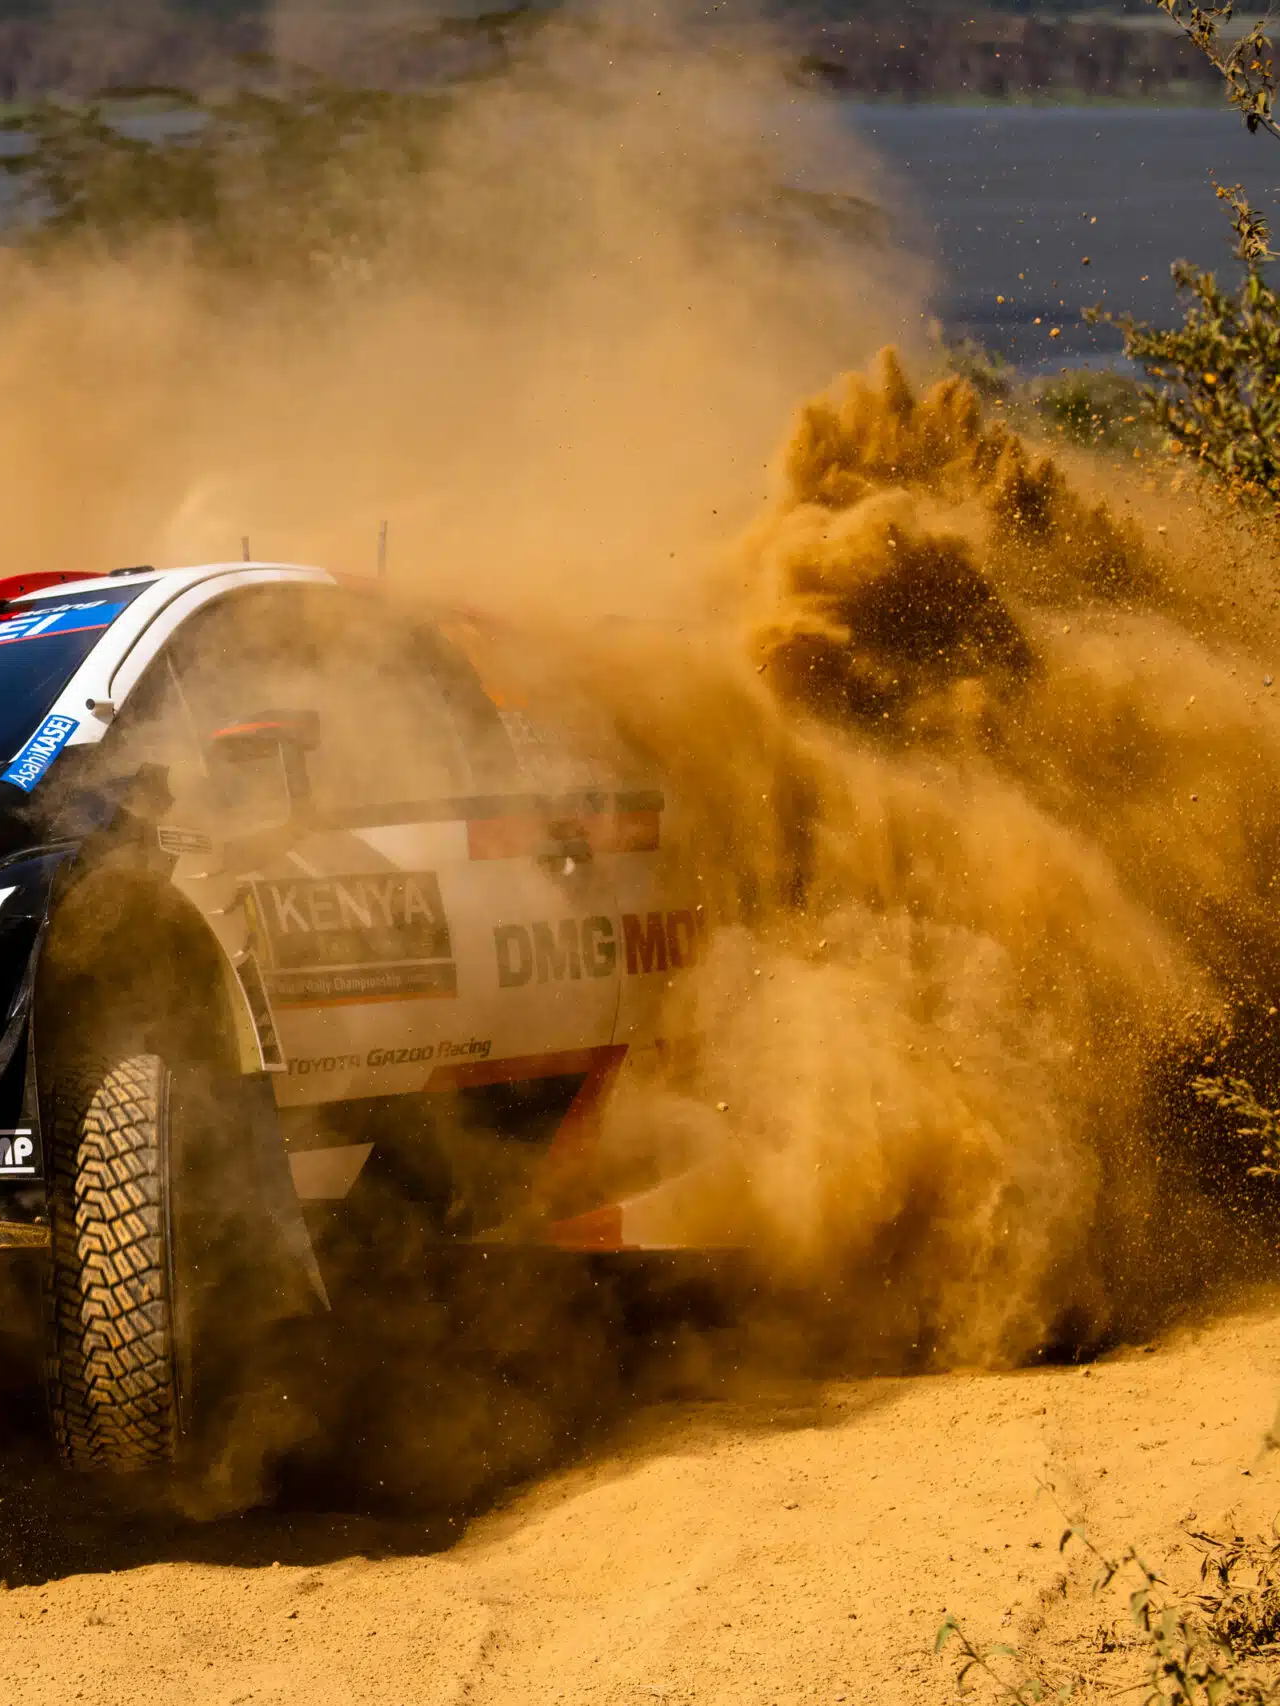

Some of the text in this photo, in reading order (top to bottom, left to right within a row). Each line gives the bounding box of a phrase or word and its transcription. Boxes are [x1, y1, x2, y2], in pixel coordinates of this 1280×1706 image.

[8, 715, 76, 789] AsahiKASEI
[269, 877, 436, 933] KENYA
[493, 915, 617, 989] DMG
[287, 1037, 493, 1076] TOYOTA GAZOO Racing
